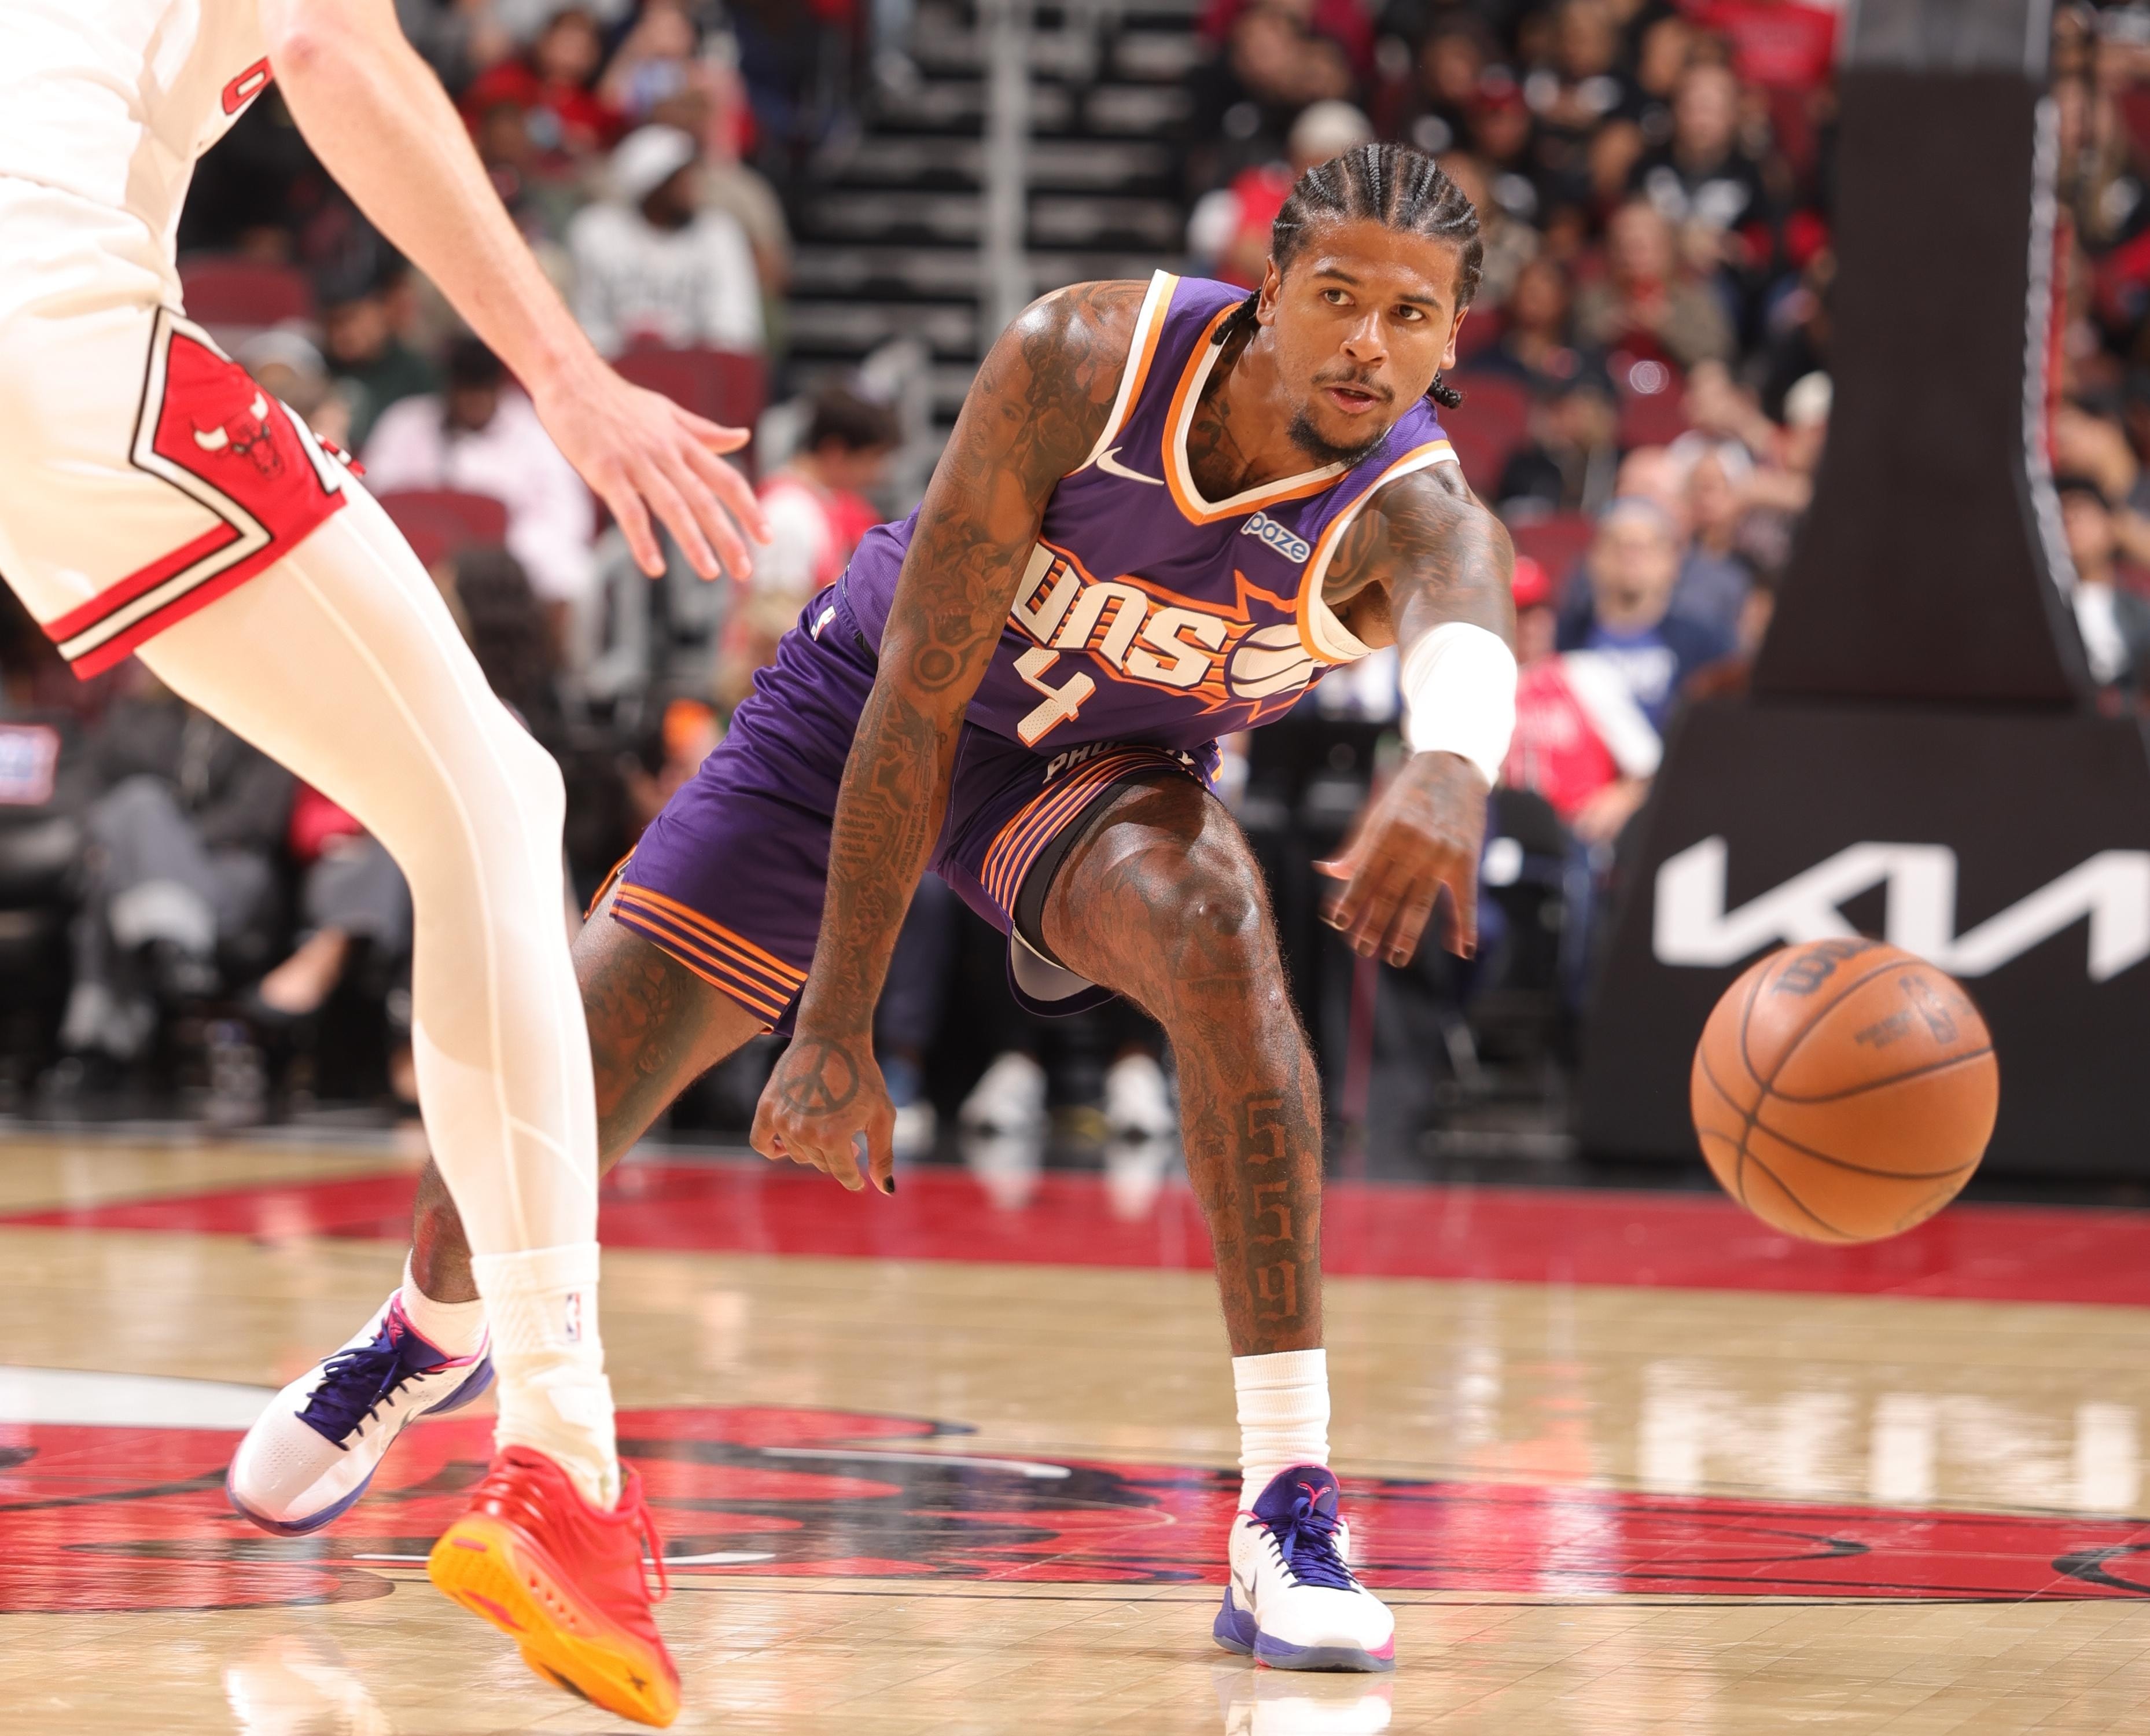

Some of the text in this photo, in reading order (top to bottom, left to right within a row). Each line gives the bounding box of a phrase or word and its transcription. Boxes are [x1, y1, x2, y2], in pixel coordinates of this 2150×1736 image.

[1243, 513, 1308, 560] paze
[1011, 542, 1228, 687] UNS
[1013, 647, 1096, 747] 4
